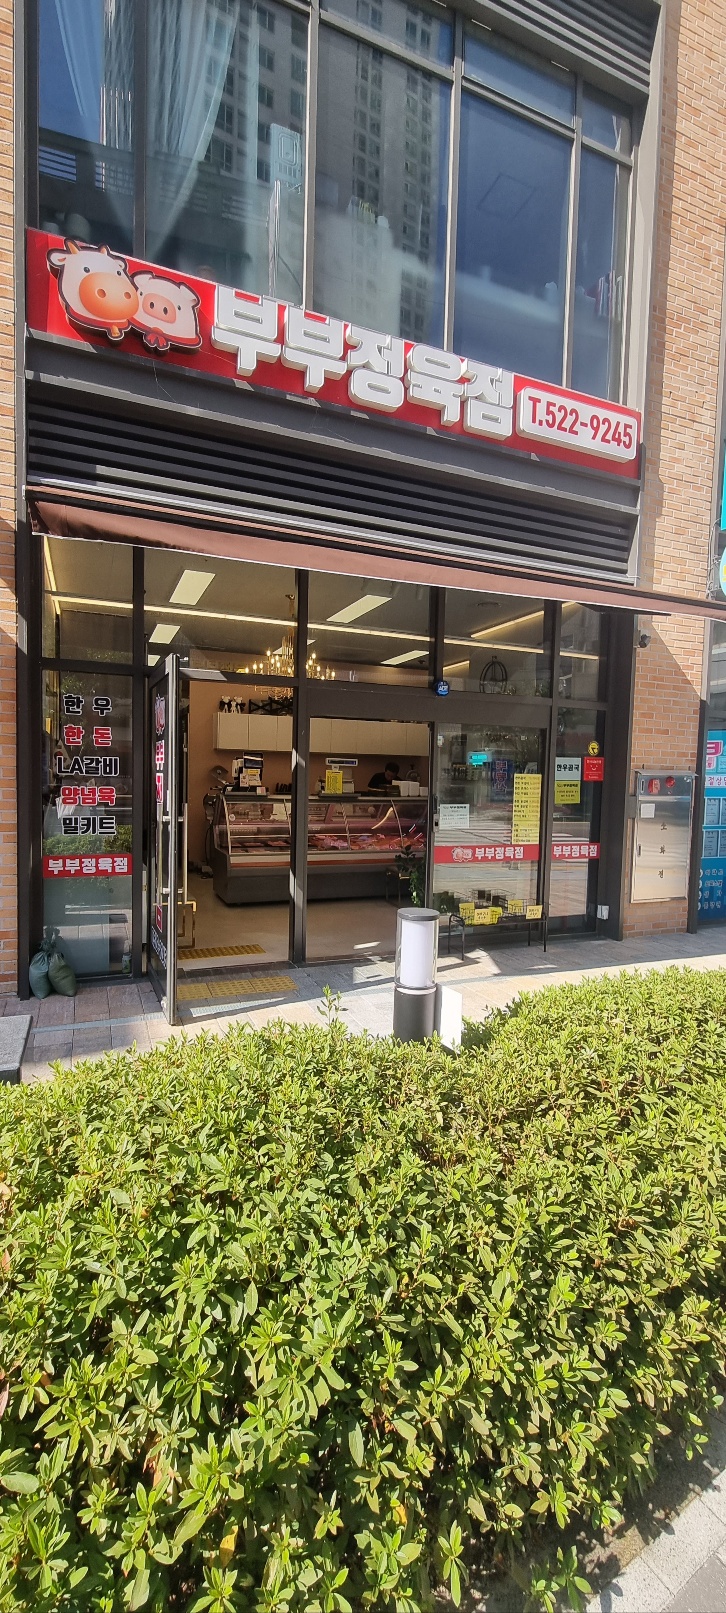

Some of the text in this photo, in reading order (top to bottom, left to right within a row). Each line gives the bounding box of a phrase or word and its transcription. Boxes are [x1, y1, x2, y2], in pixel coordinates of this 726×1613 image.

[211, 284, 514, 440] 부부정육점
[528, 396, 633, 449] T.522-9245
[56, 756, 119, 776] LA갈비
[60, 786, 116, 806] 양념육
[62, 816, 116, 835] 밀키트
[475, 846, 524, 861] 부부정육점
[553, 844, 598, 858] 부부정육점
[48, 857, 128, 875] 부부정육점
